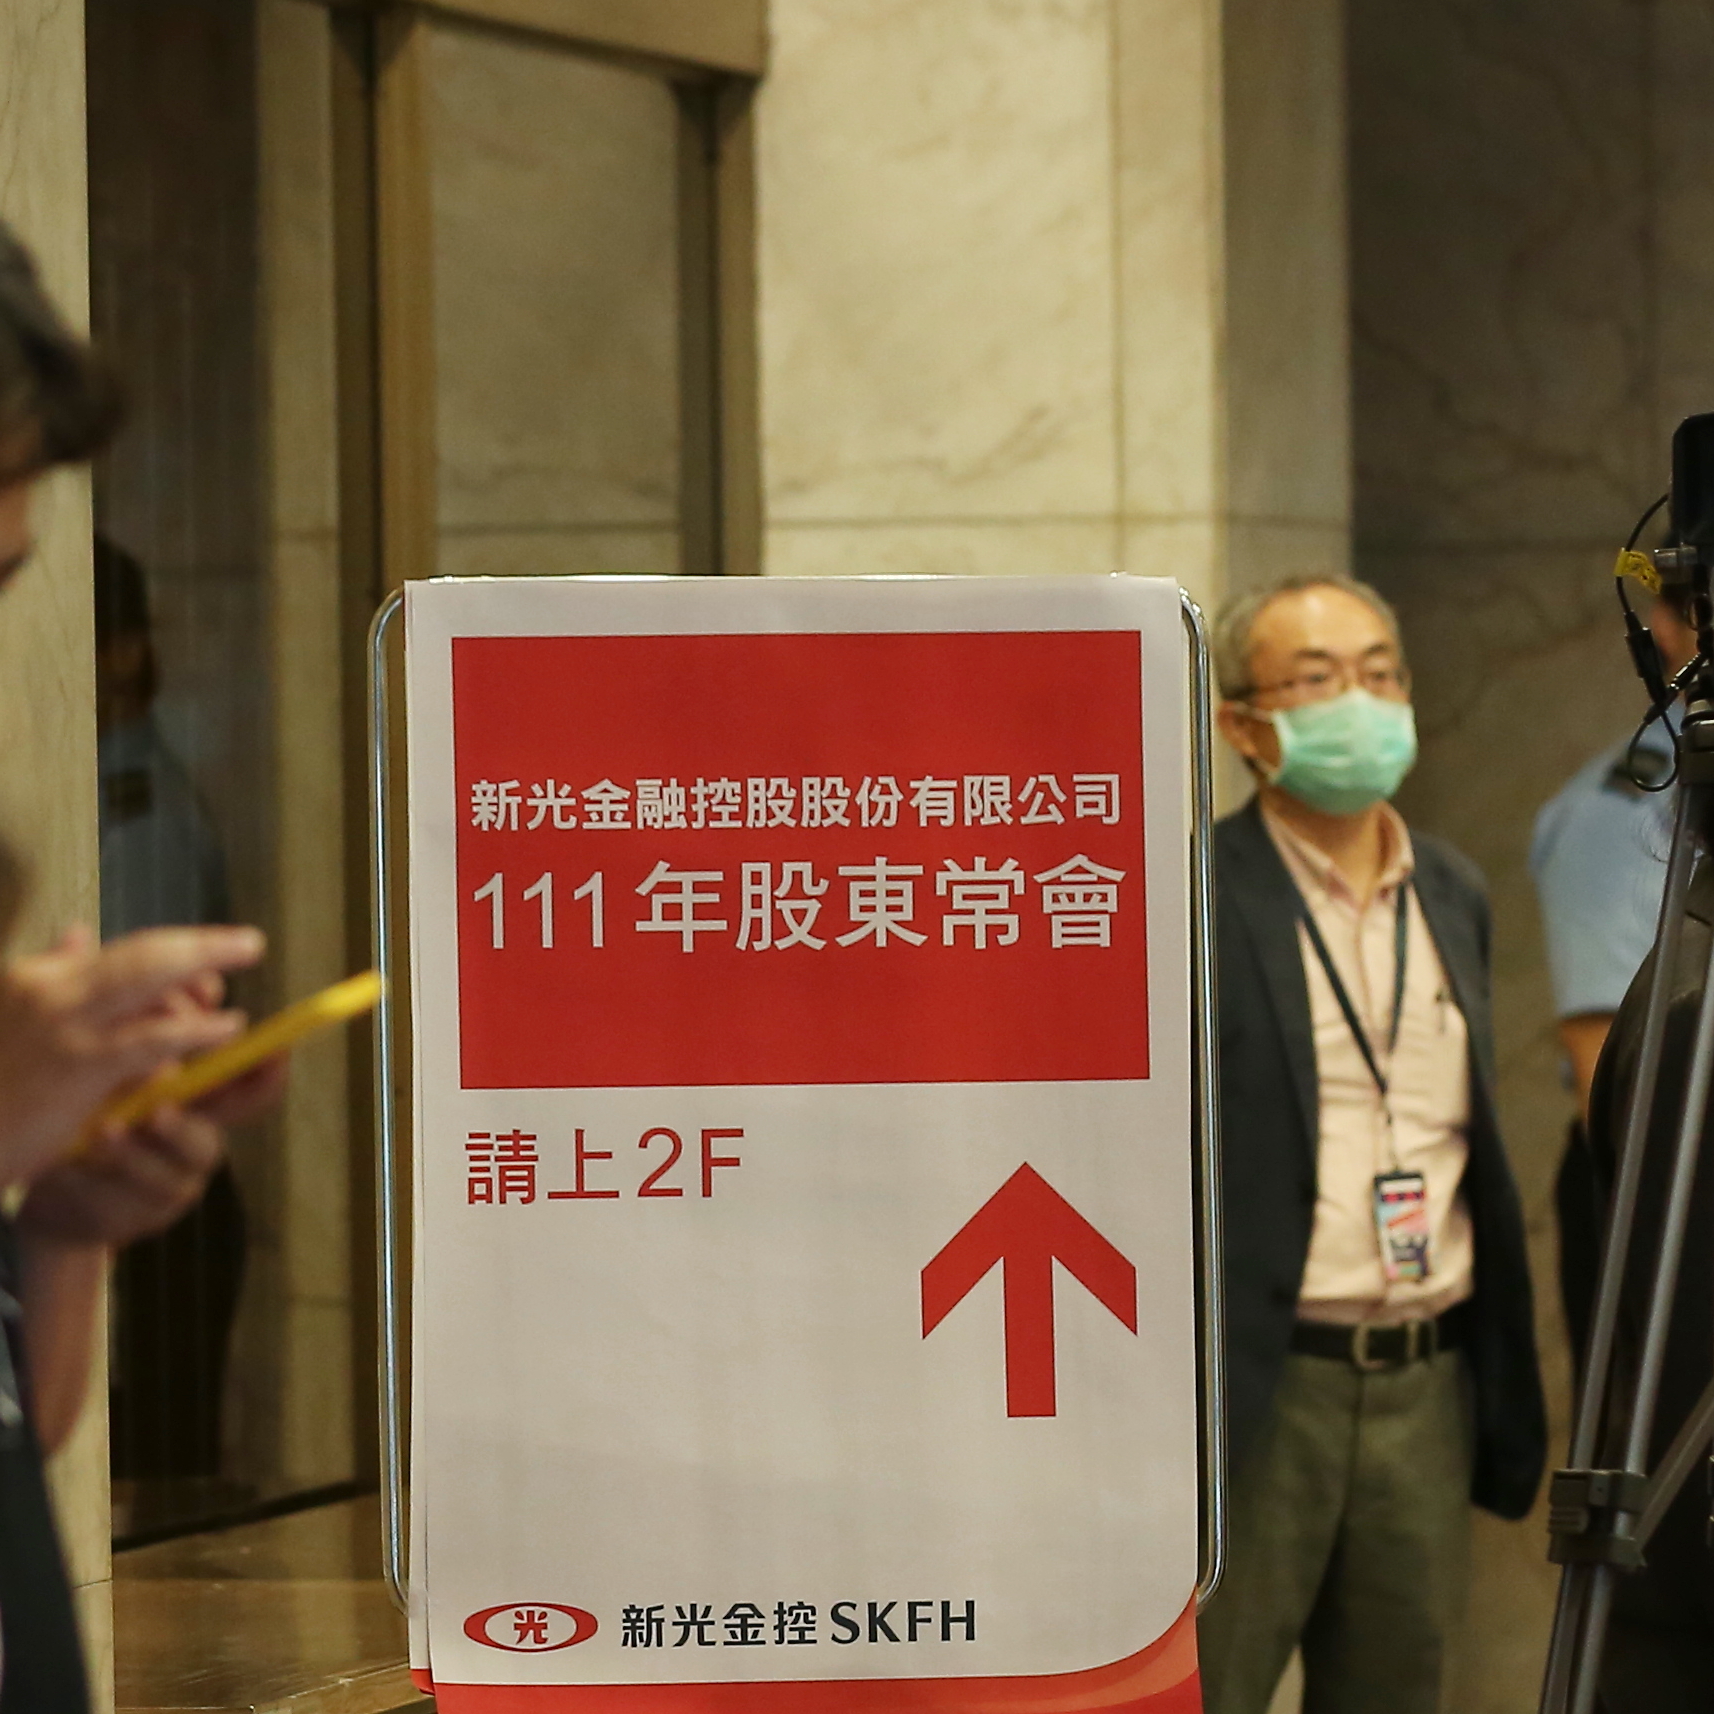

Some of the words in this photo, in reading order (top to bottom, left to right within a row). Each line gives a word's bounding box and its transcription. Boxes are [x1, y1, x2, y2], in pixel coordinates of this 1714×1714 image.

[470, 773, 1122, 832] 新光金融控股股份有限公司
[465, 1127, 744, 1205] 請上2F
